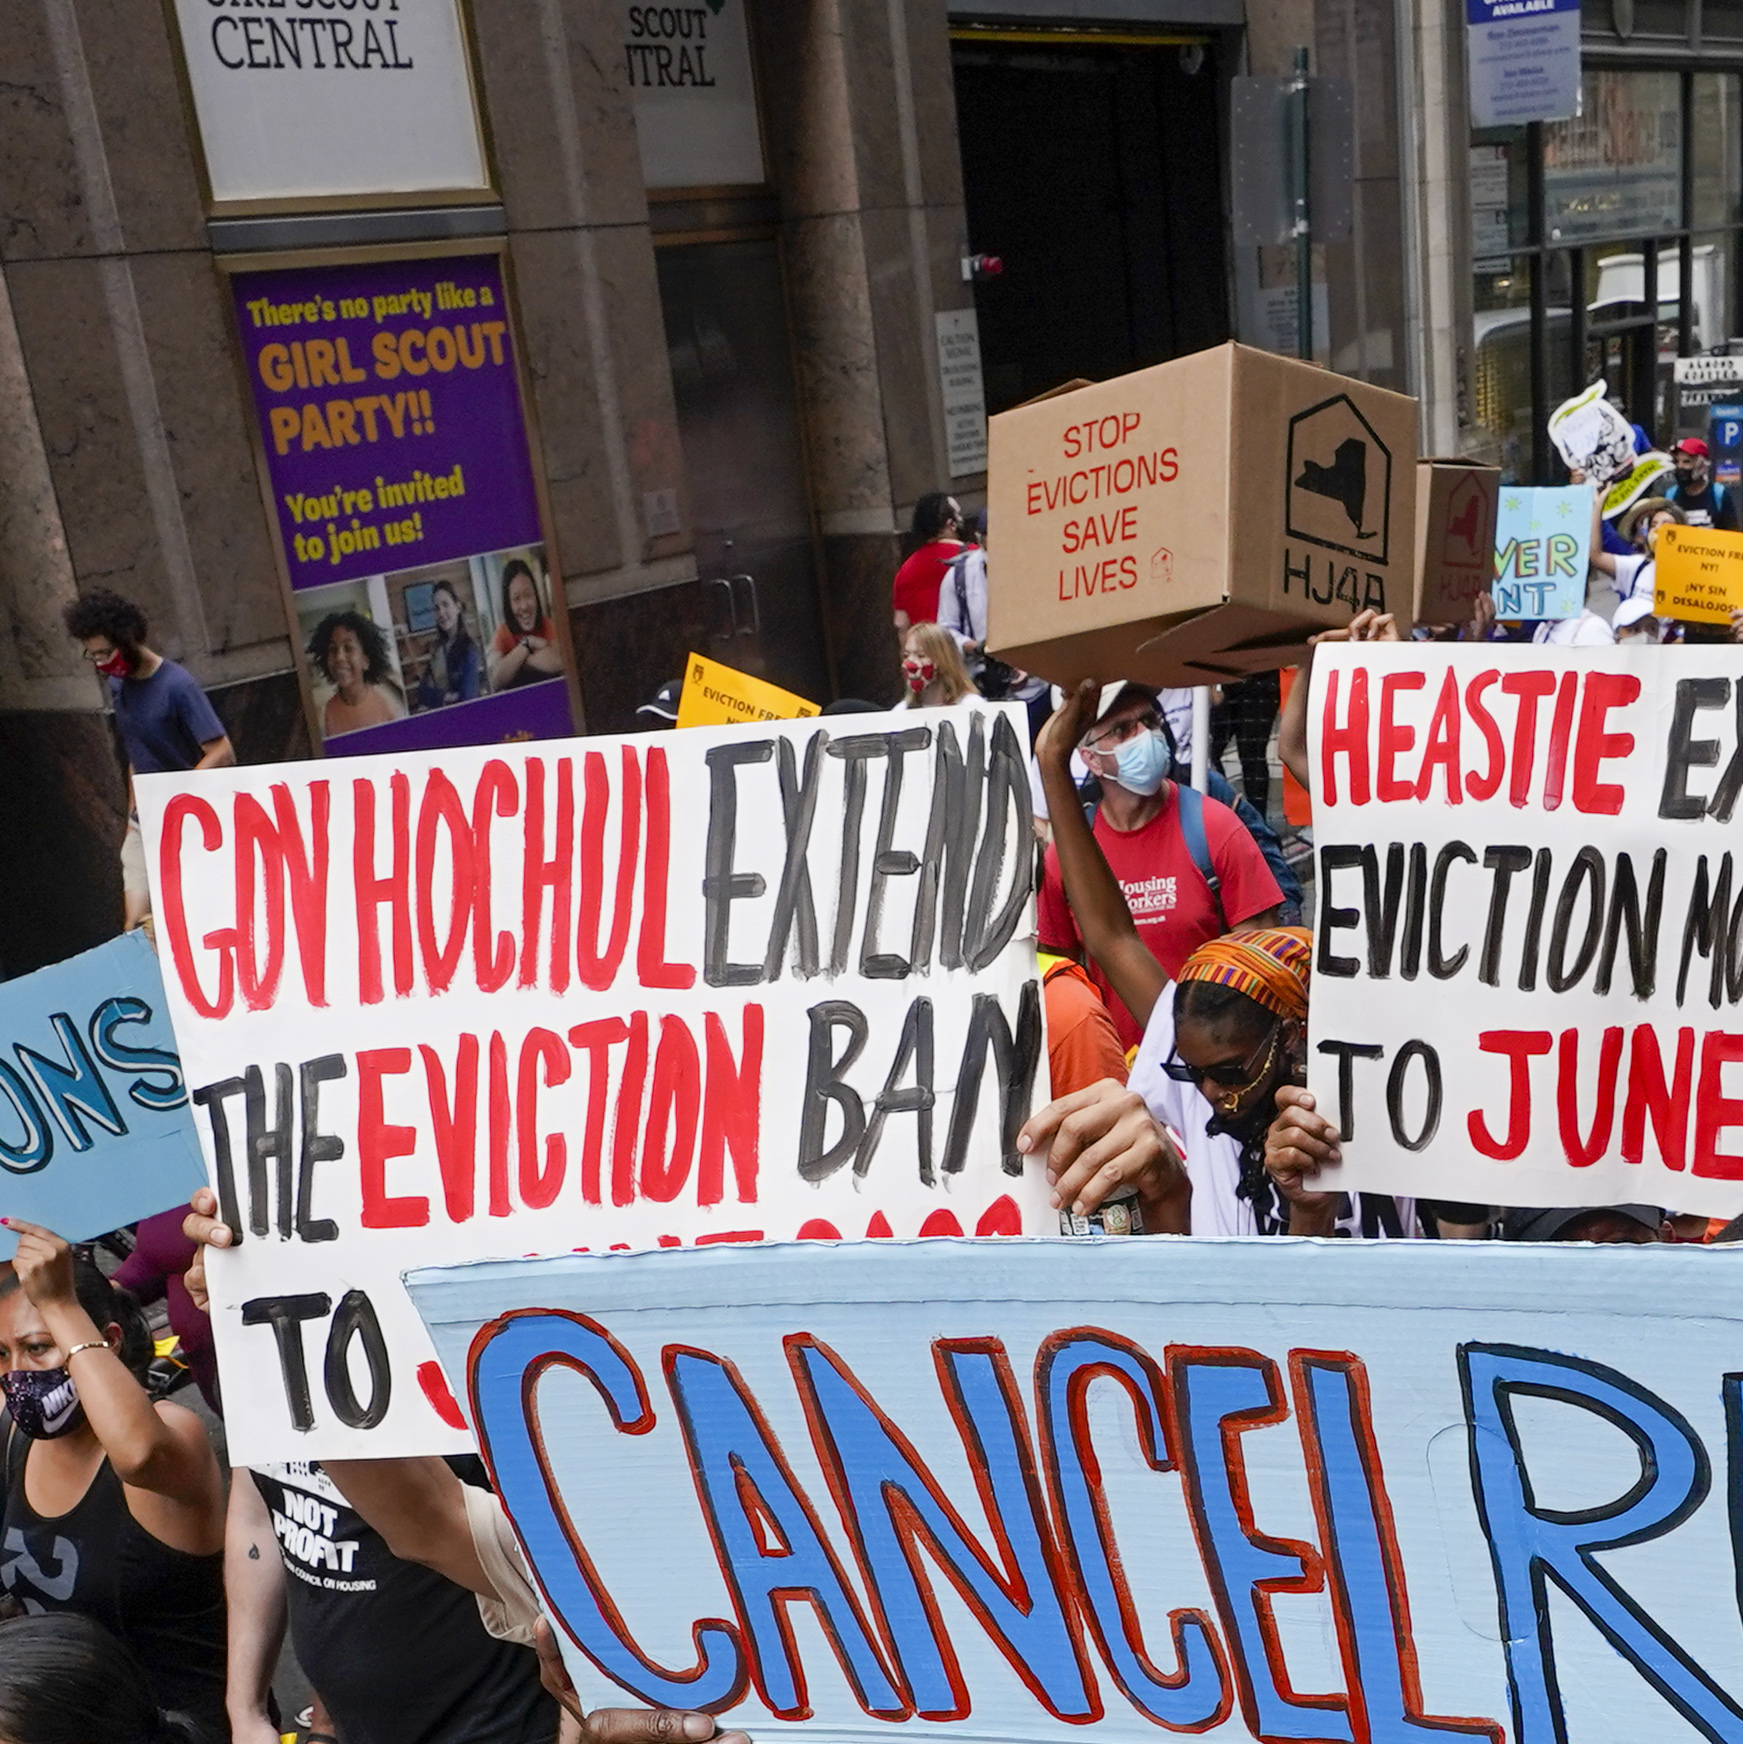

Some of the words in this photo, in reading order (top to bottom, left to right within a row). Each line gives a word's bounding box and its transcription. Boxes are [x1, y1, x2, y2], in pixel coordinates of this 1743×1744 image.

[629, 5, 707, 38] SCOUT
[1492, 0, 1555, 17] AVAILABLE
[212, 15, 413, 69] CENTRAL
[247, 295, 336, 327] There's
[340, 297, 369, 318] no
[373, 287, 432, 324] party
[435, 281, 476, 310] like
[480, 286, 495, 306] a
[258, 337, 366, 392] GIRL
[372, 320, 506, 379] SCOUT
[269, 389, 435, 455] PARTY!!
[1063, 411, 1141, 459] STOP
[1725, 421, 1740, 447] P
[285, 485, 373, 523] You're
[375, 464, 465, 508] invited
[1026, 447, 1179, 516] EVICTIONS
[294, 533, 325, 562] to
[327, 519, 381, 565] join
[384, 512, 424, 545] us!
[1062, 506, 1138, 554] SAVE
[1677, 543, 1725, 560] EVICTION
[1058, 555, 1138, 601] LIVES
[1709, 585, 1727, 597] SIN
[702, 685, 756, 716] EVICTION
[1322, 664, 1641, 815] HEASTIE
[353, 744, 697, 1005] HOCHUL
[702, 709, 1036, 988] EXTEND
[1318, 841, 1667, 1002] EVICTION
[193, 1050, 345, 1245] THE
[357, 1001, 766, 1228] EVICTION
[796, 977, 1044, 1190] BAN
[1317, 1038, 1443, 1155] TO
[237, 1279, 392, 1433] TO
[281, 1487, 339, 1539] NOT
[270, 1507, 360, 1574] PROFIT
[336, 1579, 377, 1592] HOUSING
